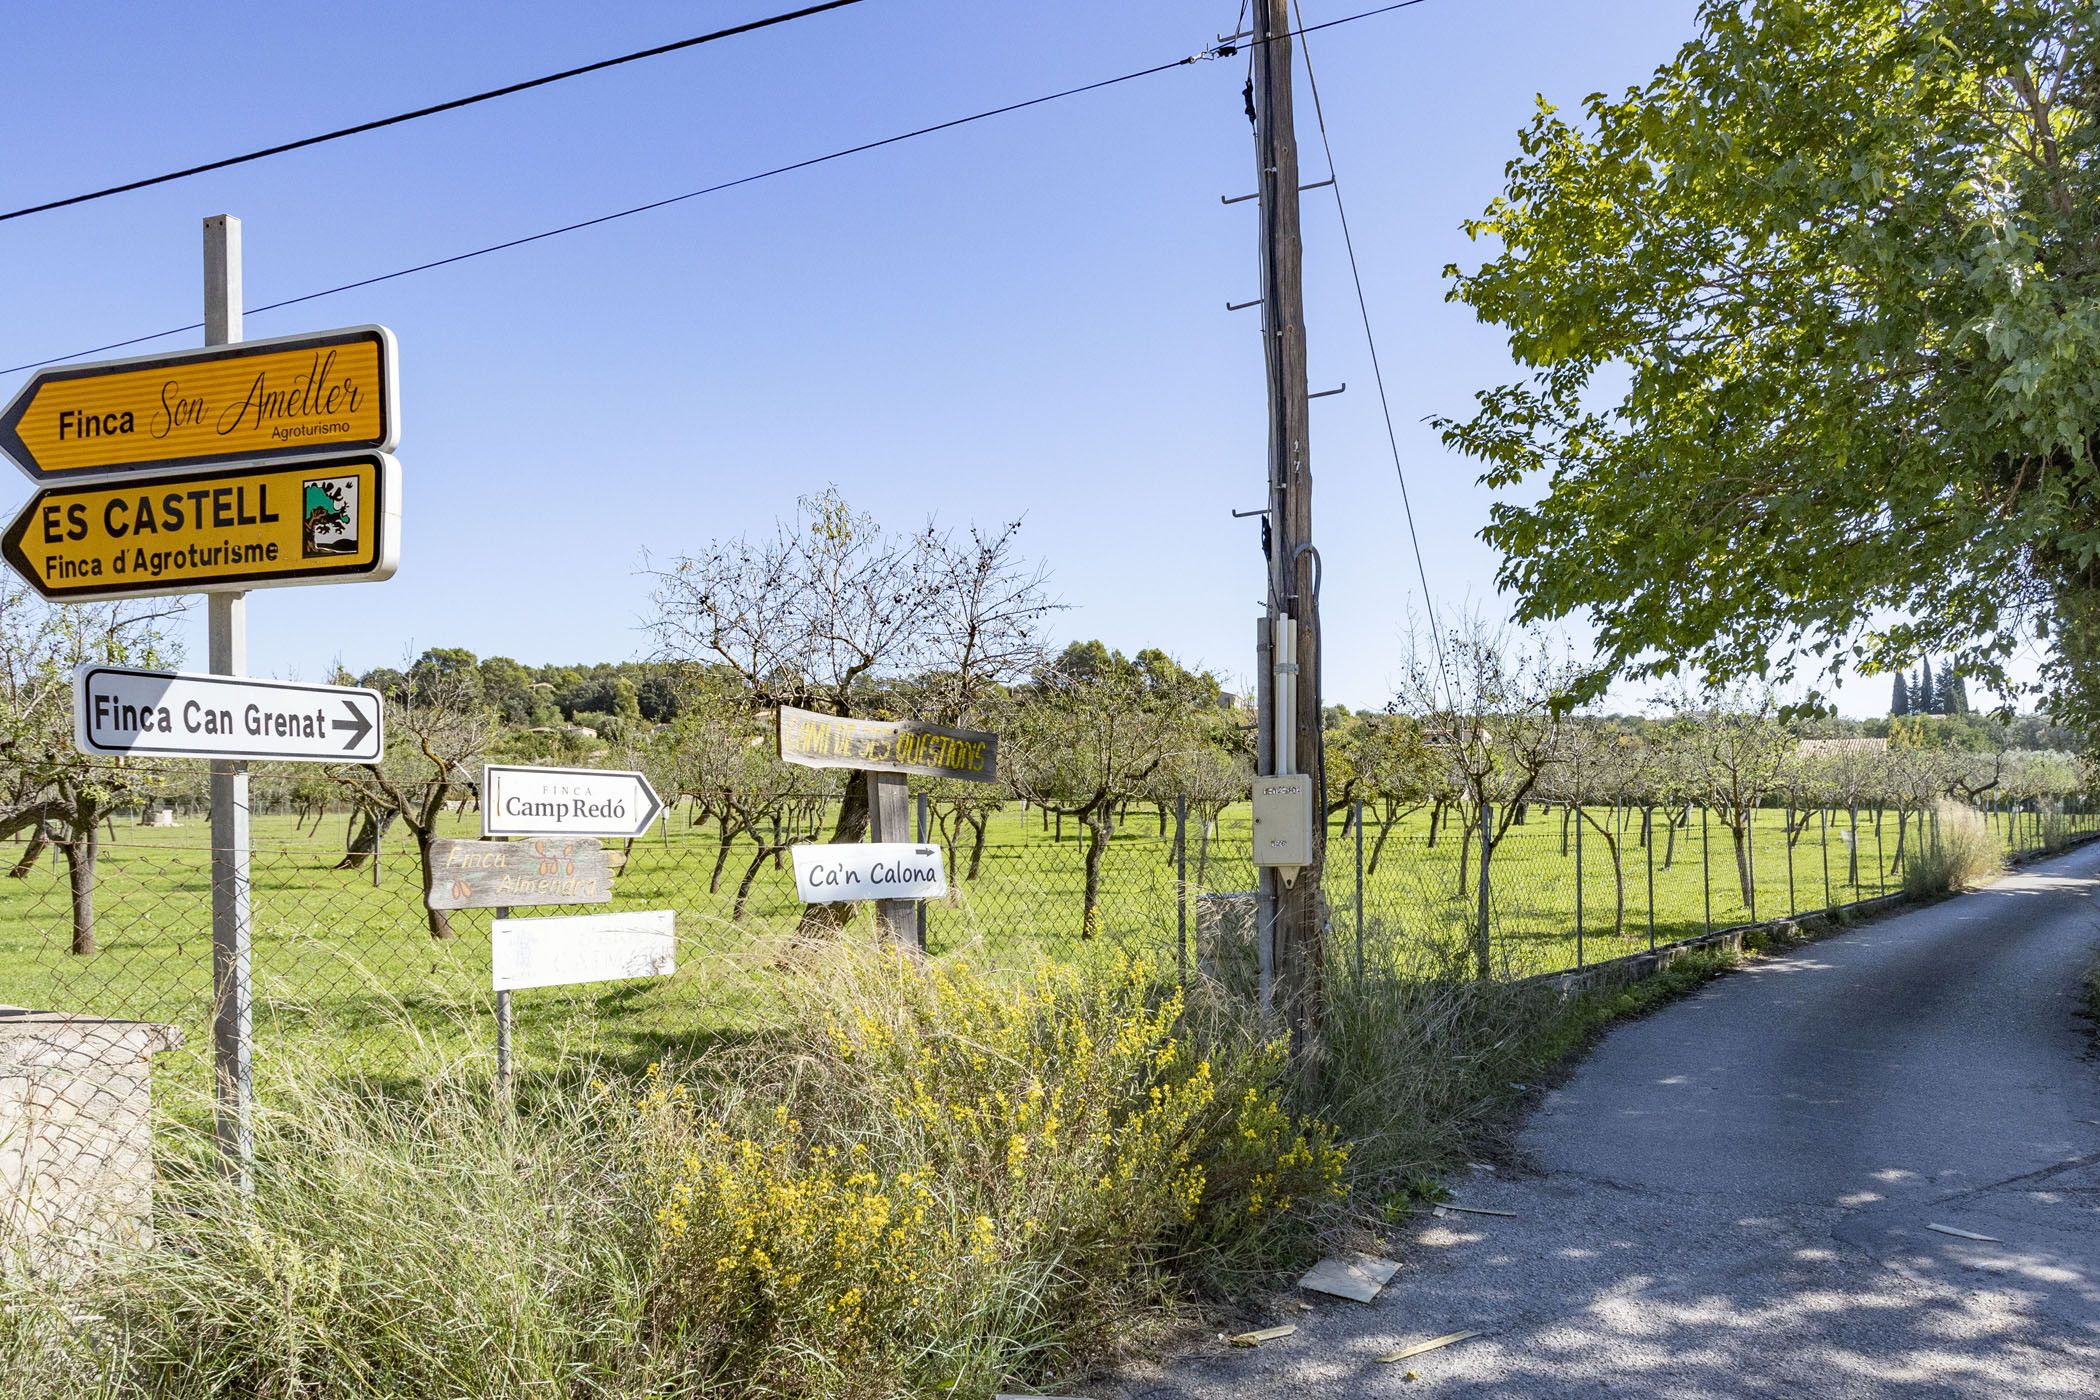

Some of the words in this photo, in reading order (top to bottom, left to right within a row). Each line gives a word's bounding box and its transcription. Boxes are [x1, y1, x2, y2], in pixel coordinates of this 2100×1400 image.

[59, 409, 135, 441] Finca
[149, 380, 209, 439] Son
[272, 422, 350, 441] Agroturismo
[43, 503, 88, 544] ES
[104, 484, 279, 538] CASTELL
[46, 555, 102, 580] Finca
[94, 694, 172, 732] Finca
[183, 699, 233, 735] Can
[244, 703, 326, 739] Grenat
[896, 732, 986, 772] QUESTIONS
[543, 785, 592, 796] FINCA
[506, 797, 569, 822] Camp
[573, 799, 625, 818] Redó
[445, 845, 507, 870] Finca
[809, 863, 860, 888] Ca'n
[870, 861, 937, 885] Calona
